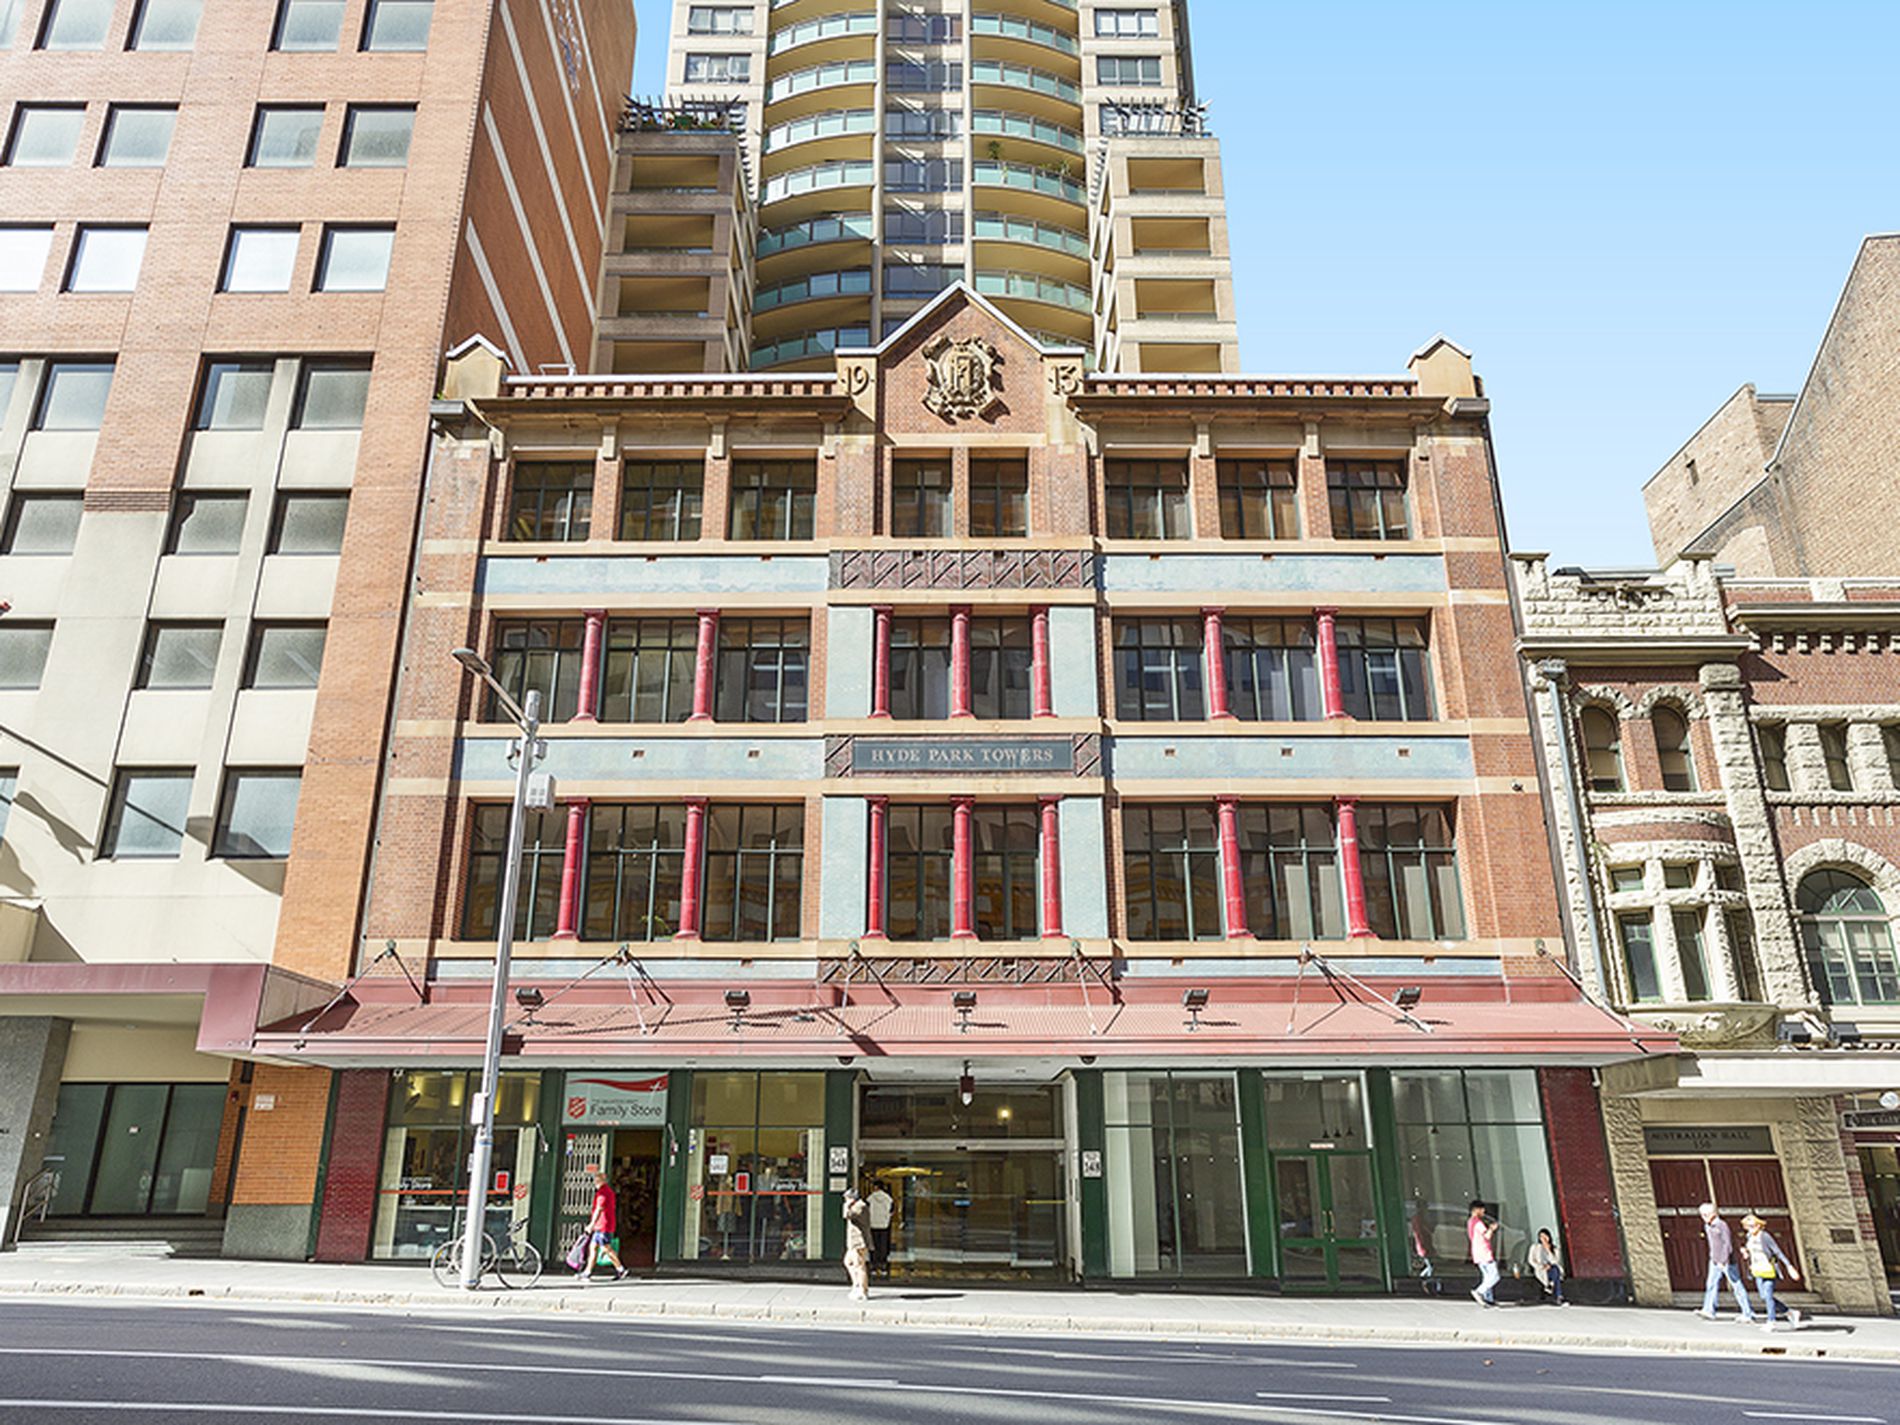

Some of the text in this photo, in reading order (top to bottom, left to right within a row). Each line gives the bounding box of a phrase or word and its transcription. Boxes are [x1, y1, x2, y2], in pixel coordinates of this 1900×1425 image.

[843, 366, 869, 396] 19
[871, 748, 1053, 764] HYDE PARK TOWERS
[590, 1103, 663, 1119] Family Store
[1649, 1131, 1750, 1140] AUSTRALIAN HALL
